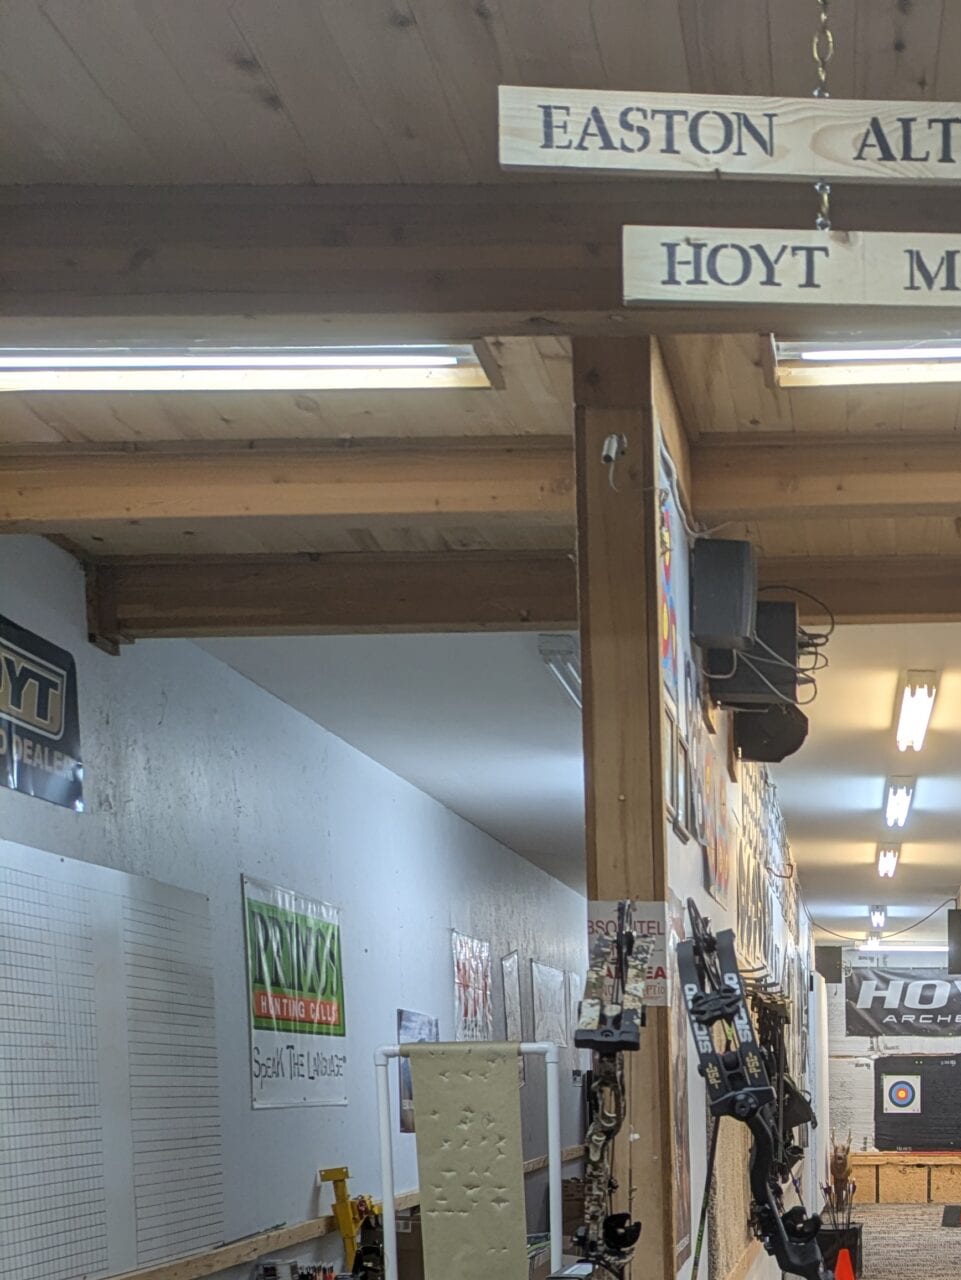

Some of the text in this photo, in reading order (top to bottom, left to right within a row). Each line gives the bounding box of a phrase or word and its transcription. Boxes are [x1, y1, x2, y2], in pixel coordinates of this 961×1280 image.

[537, 104, 779, 158] EASTON
[660, 241, 831, 289] HOYT
[0, 653, 61, 723] YT
[260, 995, 338, 1024] HUNTING CALLS
[286, 1044, 305, 1081] THE
